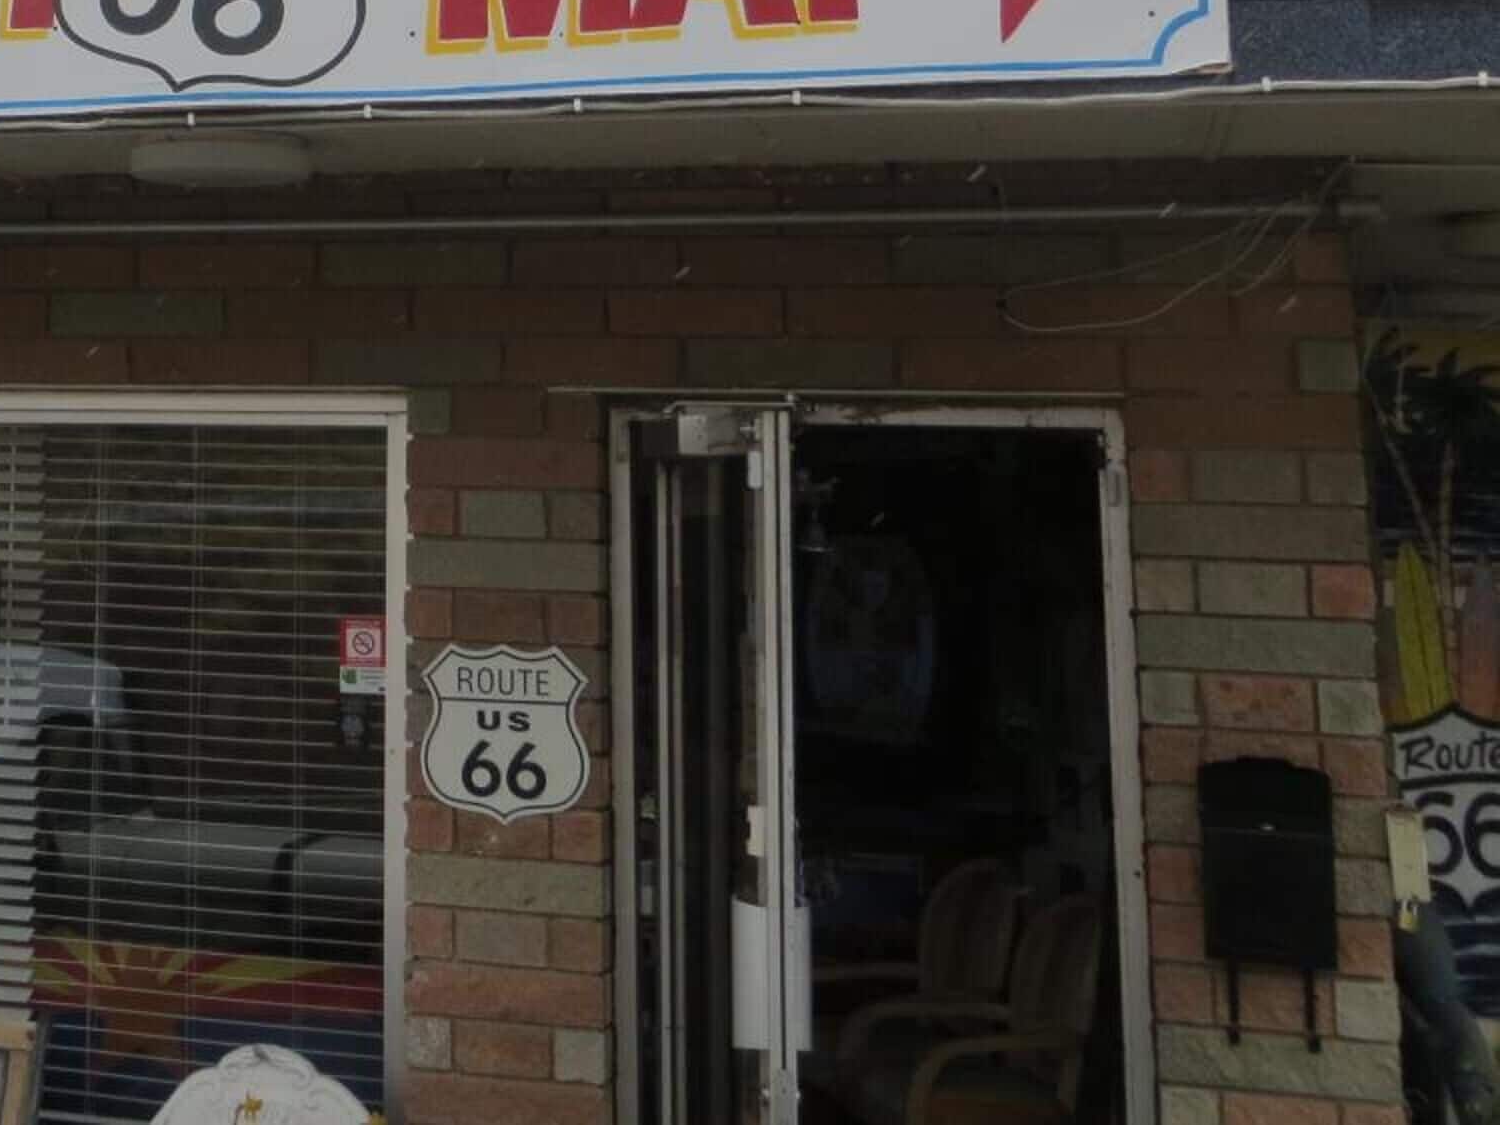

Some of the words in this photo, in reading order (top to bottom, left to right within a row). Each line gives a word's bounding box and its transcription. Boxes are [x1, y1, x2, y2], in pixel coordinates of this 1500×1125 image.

[457, 666, 550, 697] ROUTE
[476, 709, 531, 732] US
[461, 740, 547, 800] 66
